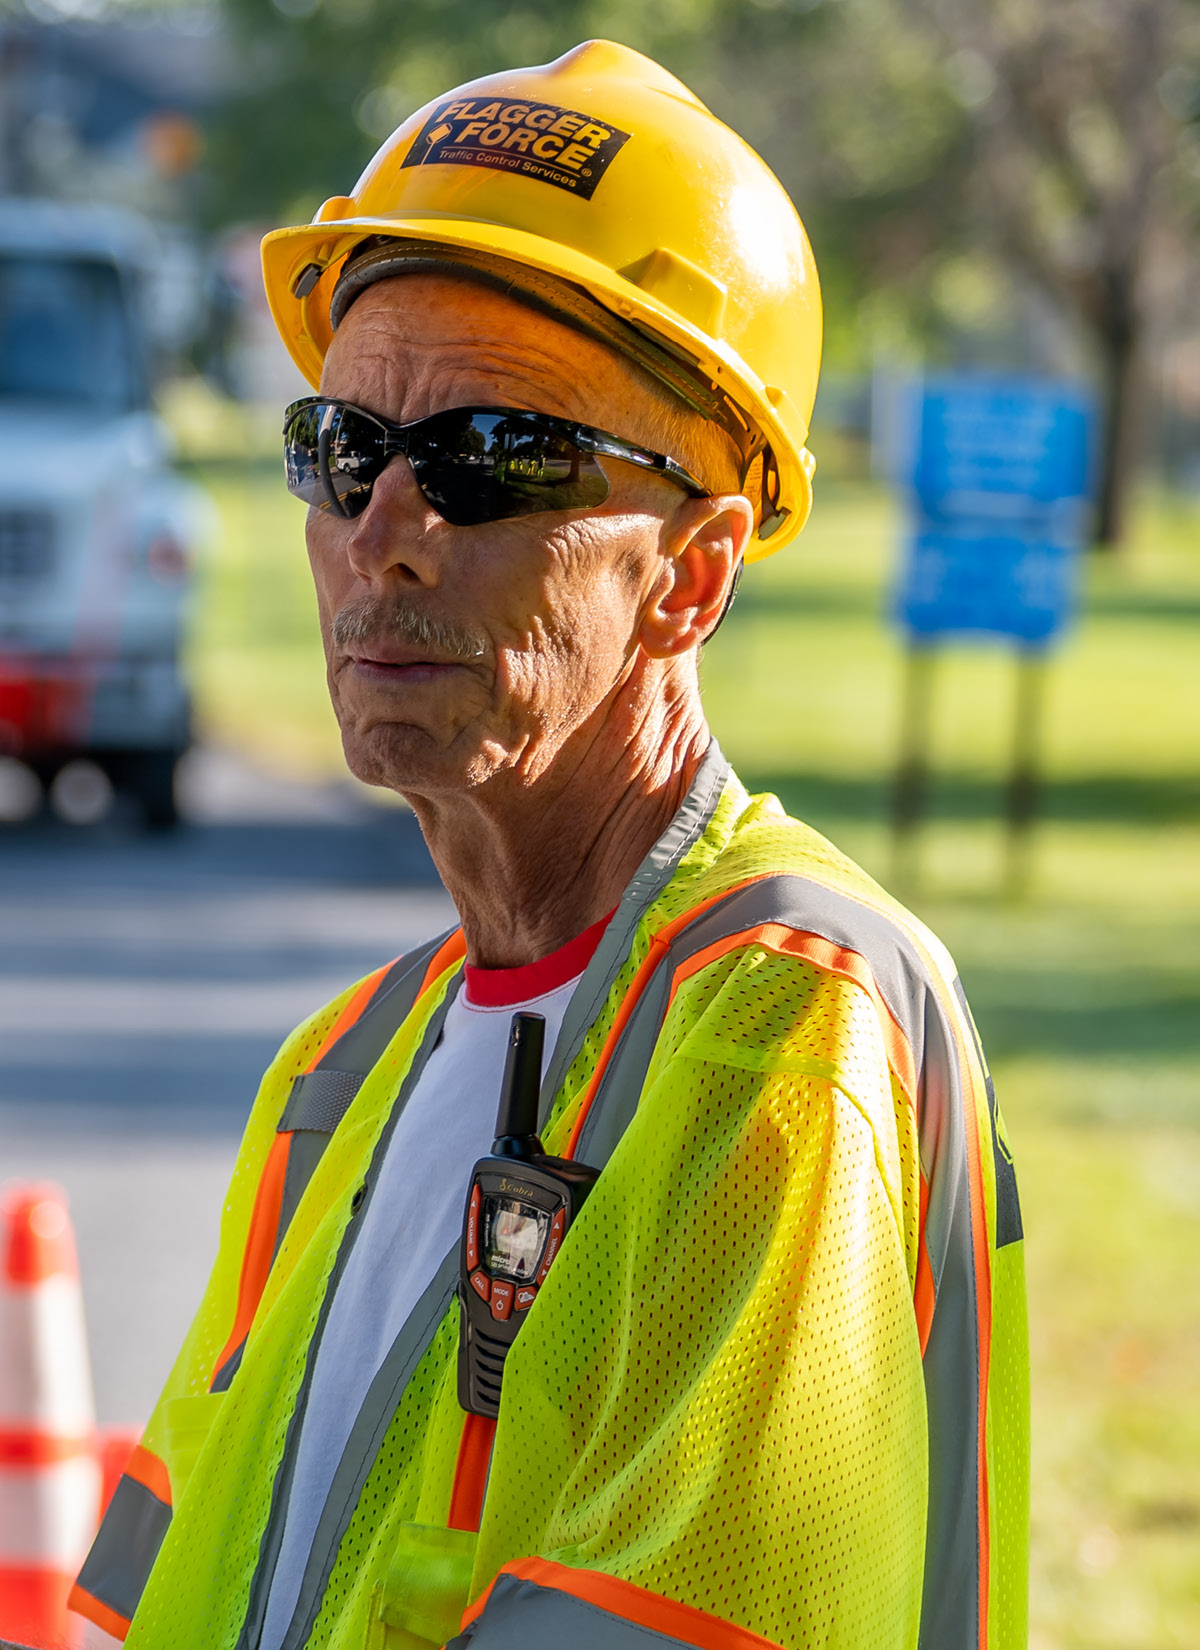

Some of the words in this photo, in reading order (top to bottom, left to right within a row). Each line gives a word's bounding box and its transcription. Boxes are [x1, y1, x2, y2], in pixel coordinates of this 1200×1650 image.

[435, 101, 612, 149] FLAGGER
[439, 150, 473, 161] Traffic
[476, 152, 520, 168] Control
[522, 161, 578, 188] Services
[507, 1183, 534, 1197] Cobra
[545, 1237, 558, 1266] CHANNEL
[474, 1277, 485, 1290] CALL
[493, 1287, 509, 1297] MODE
